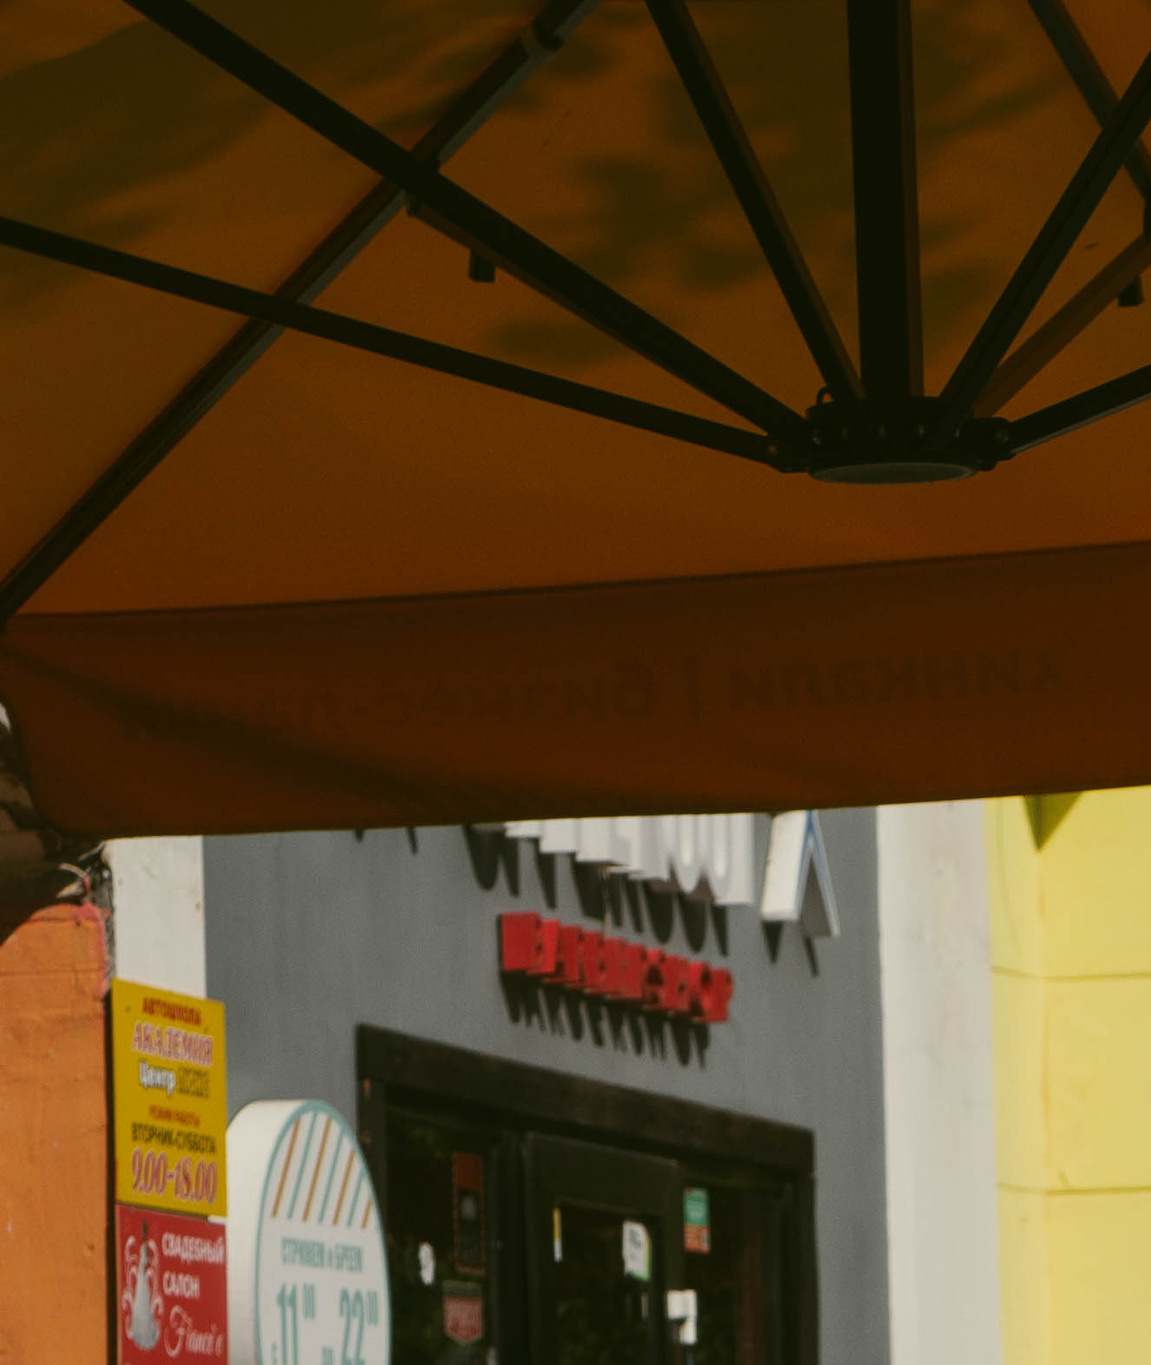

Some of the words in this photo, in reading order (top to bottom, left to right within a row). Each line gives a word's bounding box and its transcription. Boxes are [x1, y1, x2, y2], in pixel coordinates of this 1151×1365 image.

[143, 998, 201, 1027] АВТОШКОЛА
[133, 1022, 213, 1068] АКАДЕМИЯ
[139, 1061, 176, 1096] Центр
[132, 1148, 217, 1203] 9.00-18.00
[162, 1232, 225, 1266] СВАДЕБНЫЙ
[163, 1271, 200, 1300] САЛОН
